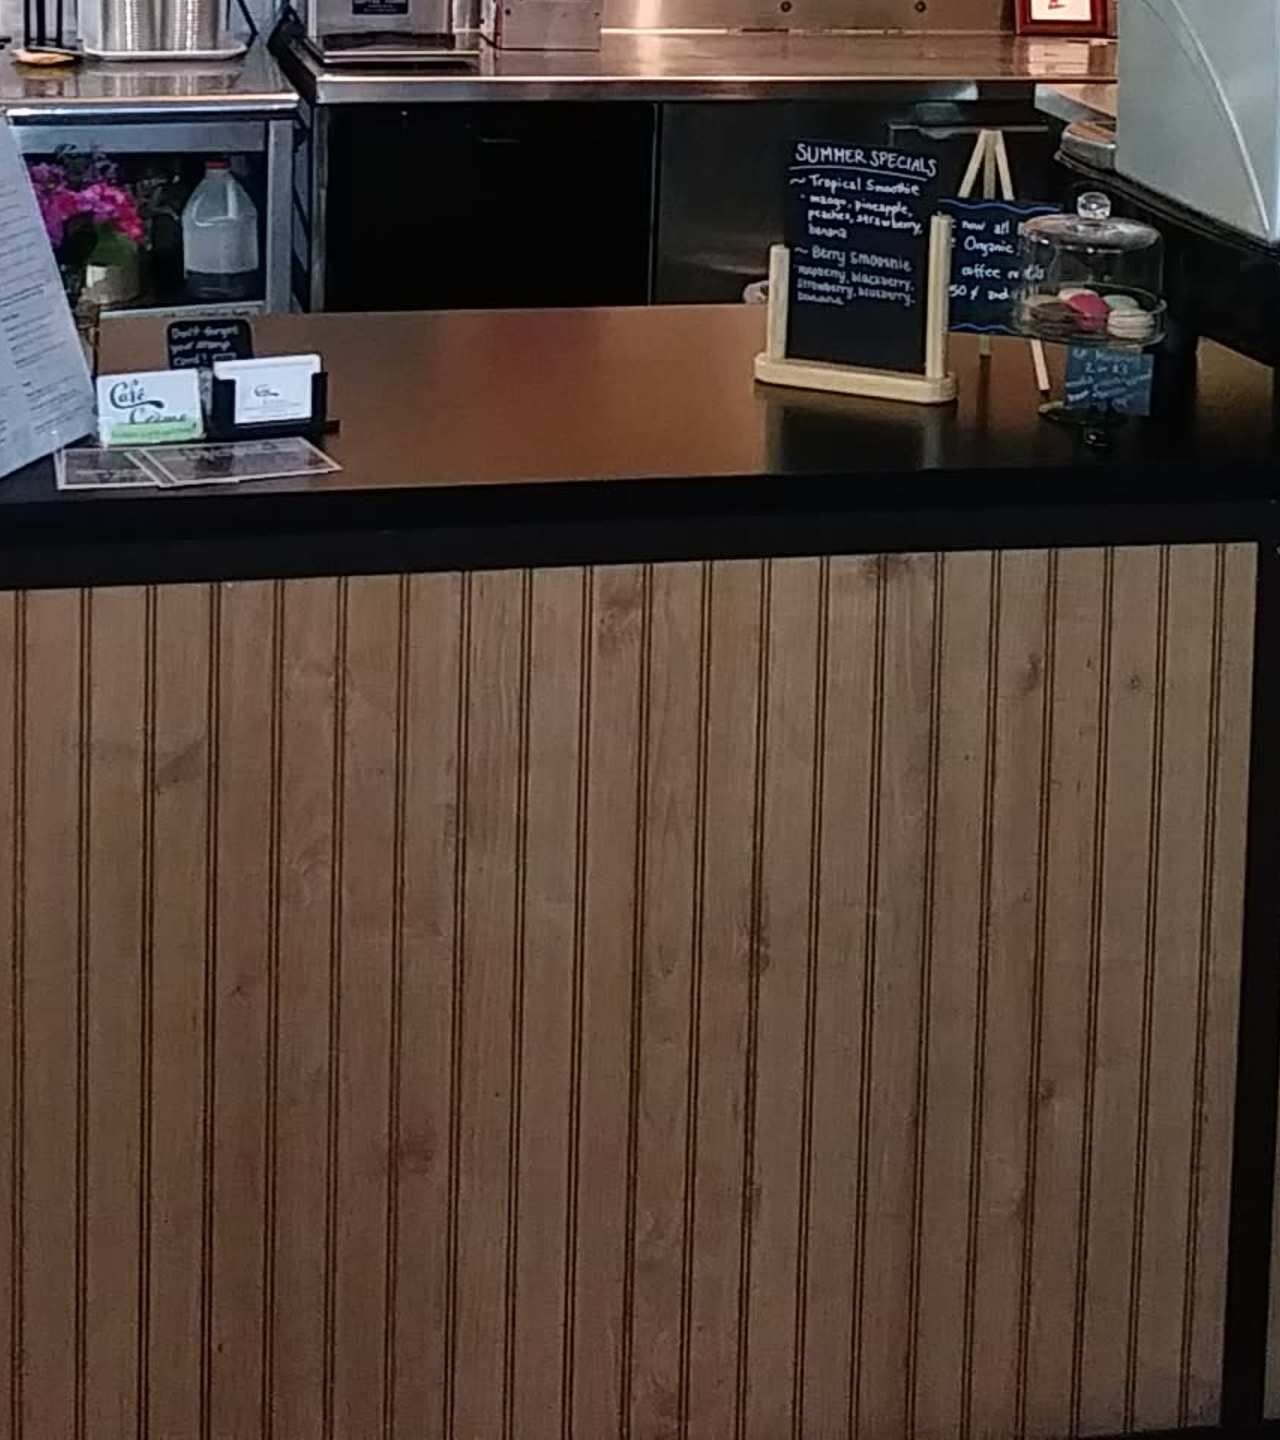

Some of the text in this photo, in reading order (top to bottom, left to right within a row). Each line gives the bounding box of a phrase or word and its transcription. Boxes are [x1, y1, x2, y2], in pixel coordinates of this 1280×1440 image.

[796, 144, 937, 177] SUMMER SPECIALS
[809, 174, 920, 196] Tropical Smoothie
